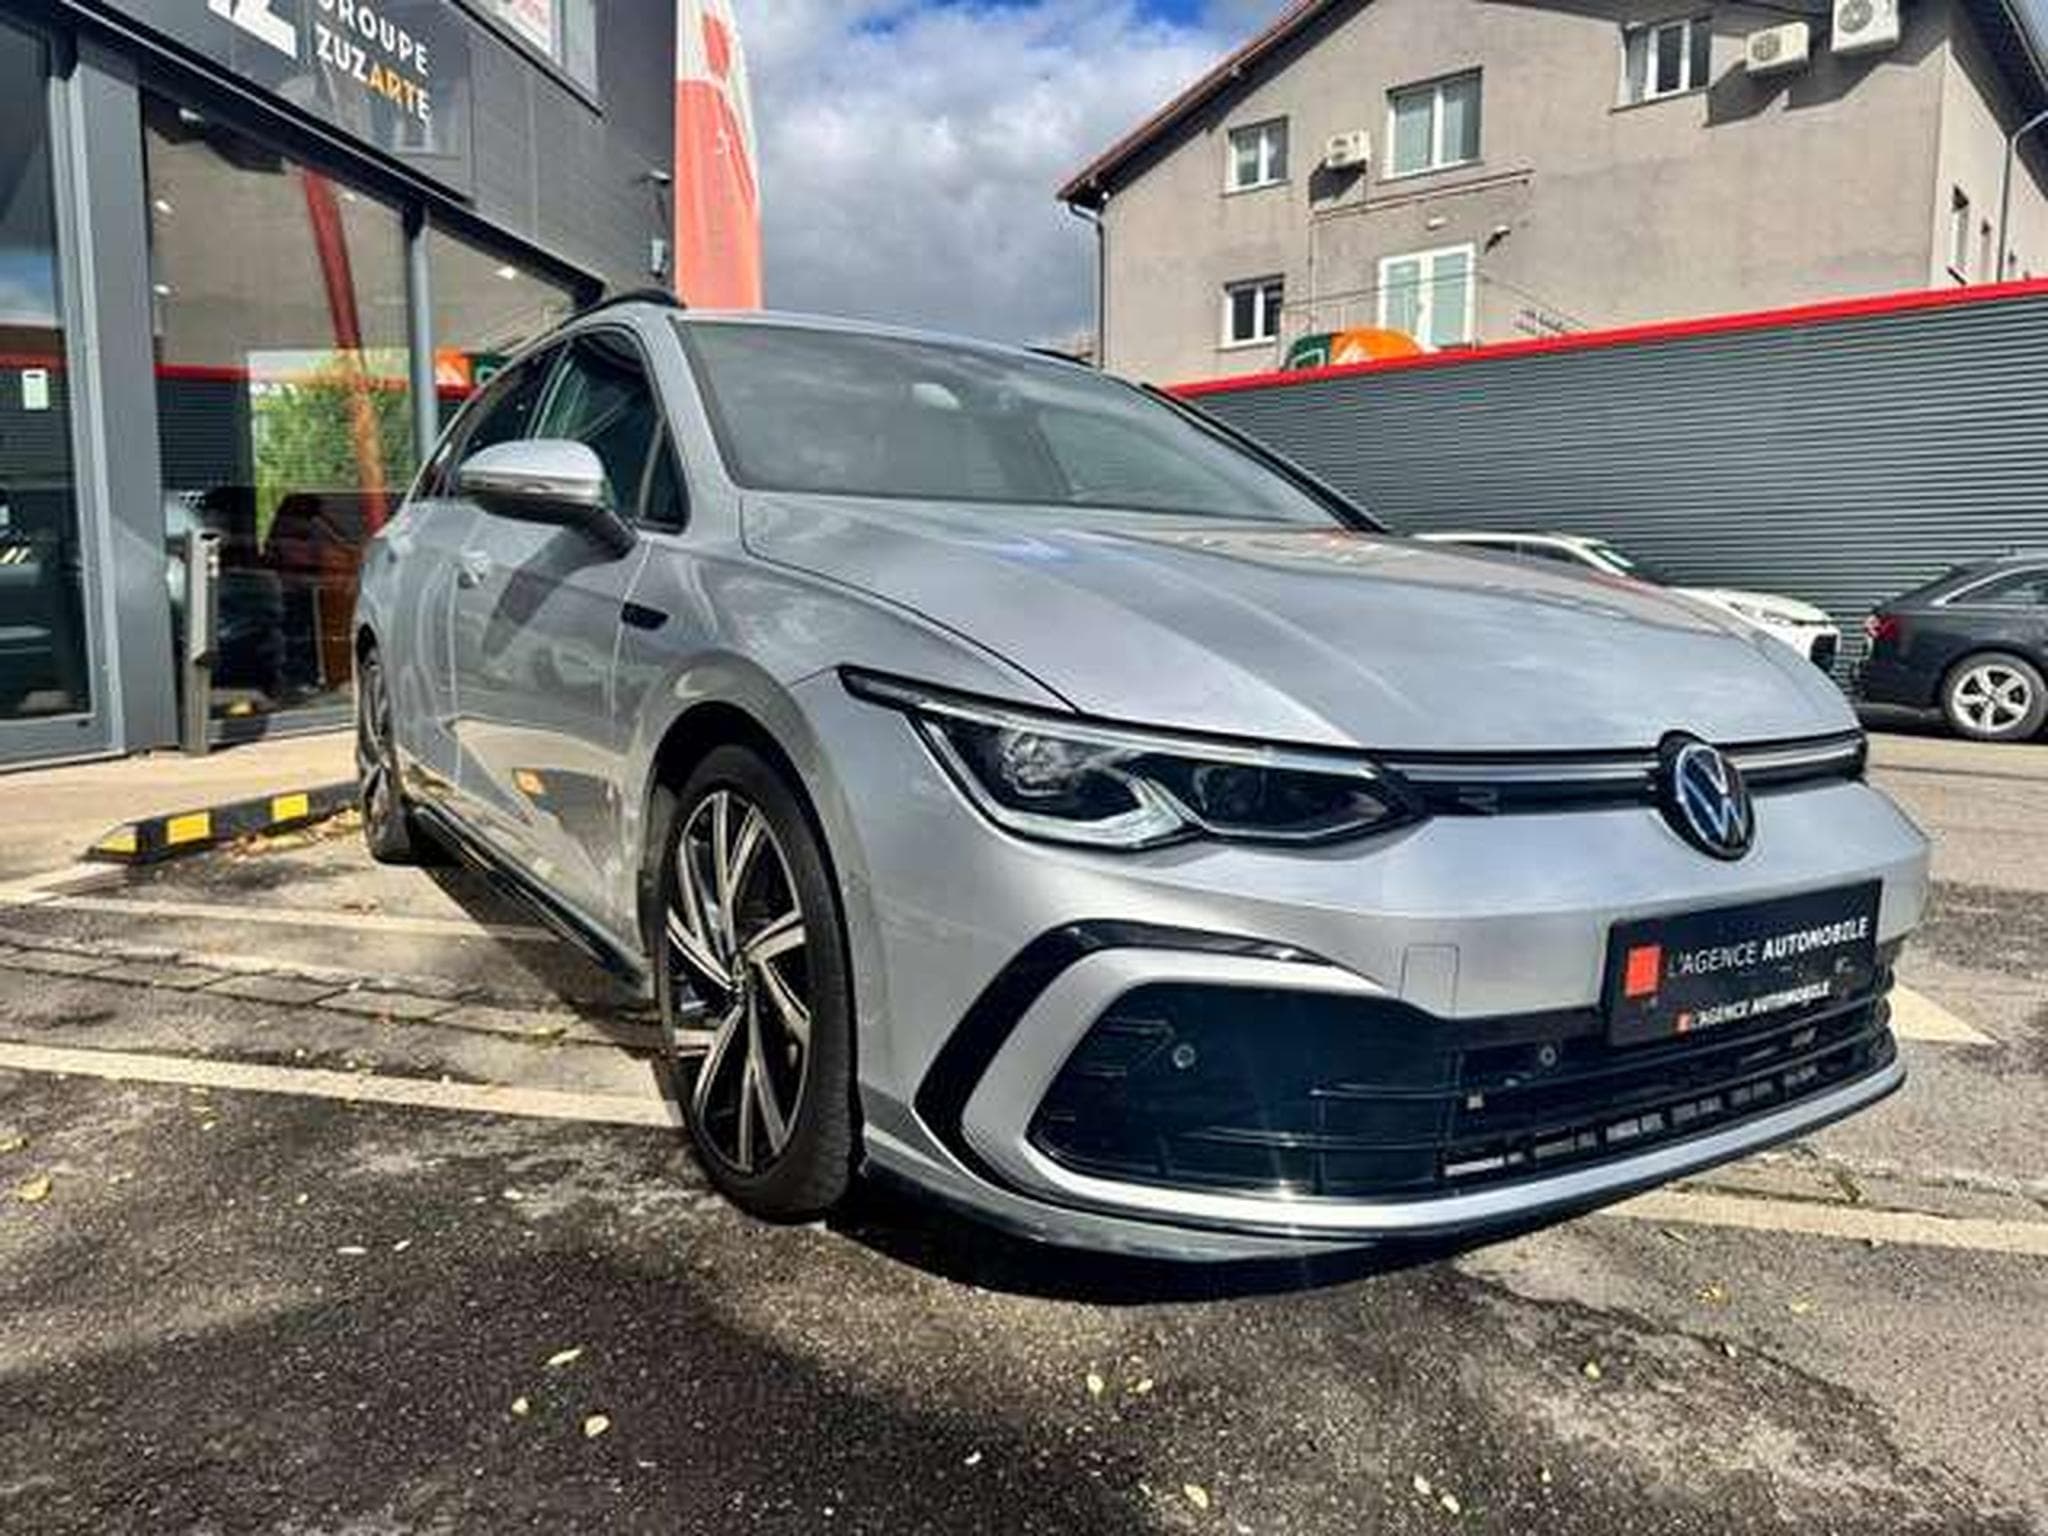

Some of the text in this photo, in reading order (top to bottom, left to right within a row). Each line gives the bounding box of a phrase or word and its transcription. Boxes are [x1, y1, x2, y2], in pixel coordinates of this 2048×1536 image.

[315, 23, 433, 121] ZUZARTE
[1668, 916, 1870, 977] L'AGENCE AUTOMOBILE
